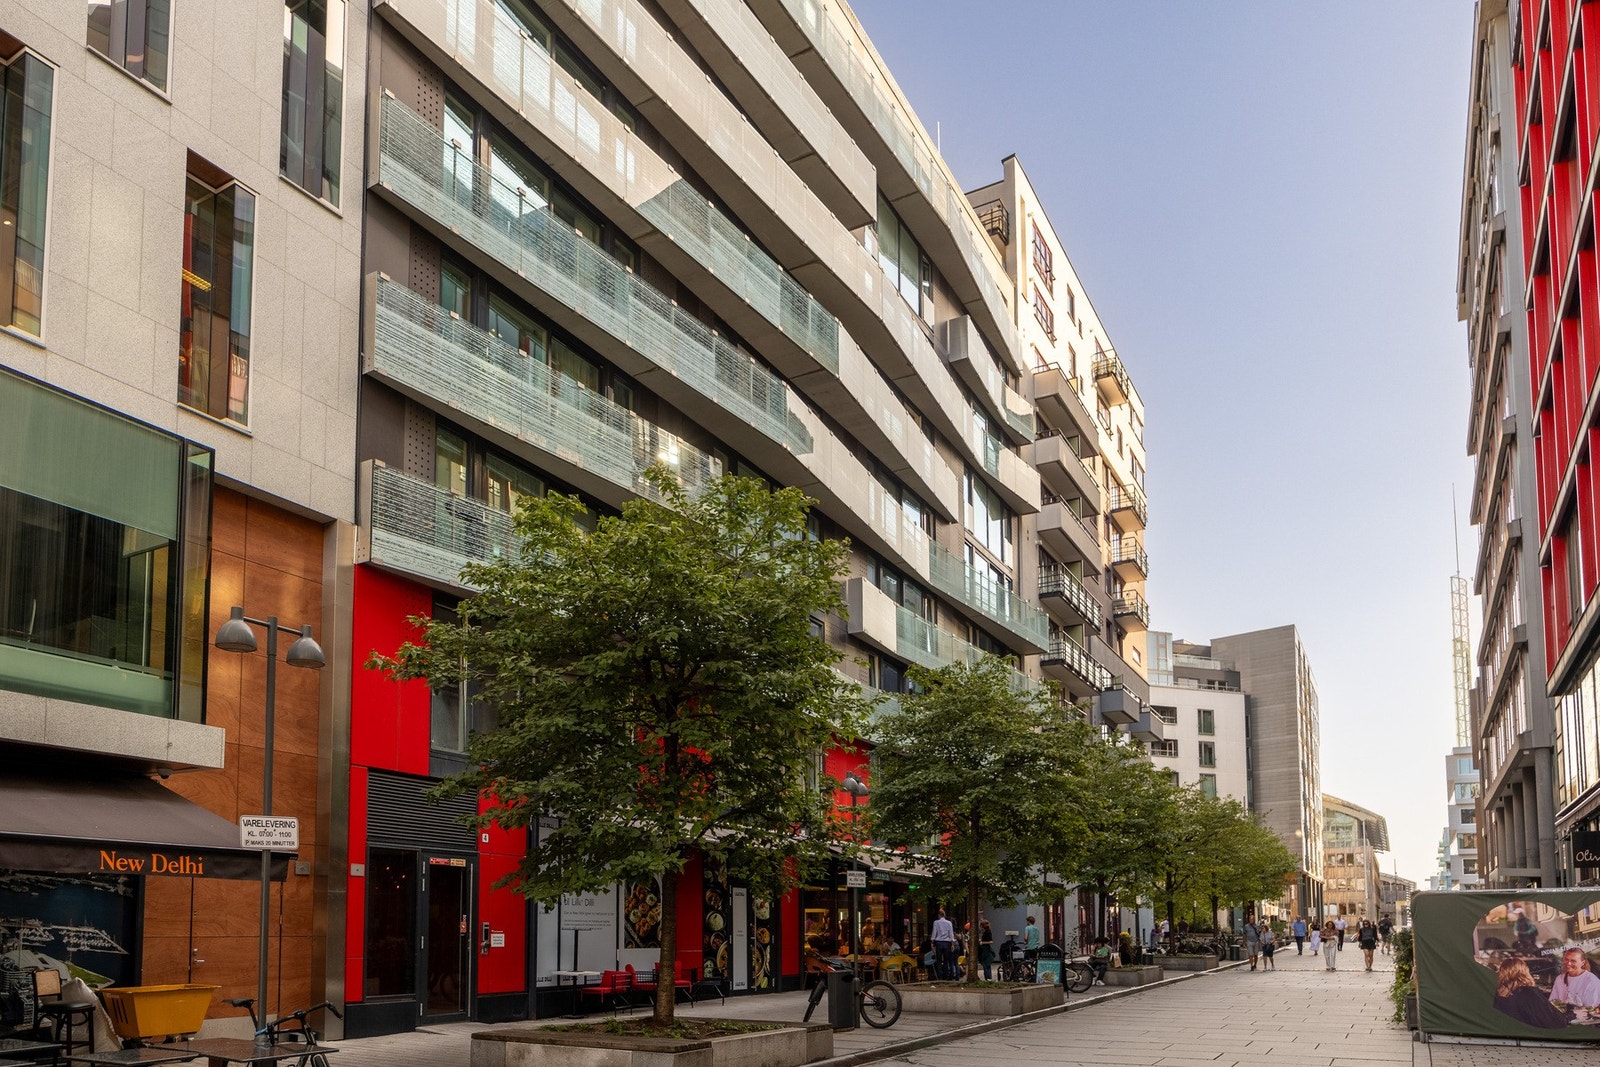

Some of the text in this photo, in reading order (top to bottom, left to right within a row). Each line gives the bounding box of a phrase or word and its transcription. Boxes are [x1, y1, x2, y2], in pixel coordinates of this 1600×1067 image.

[242, 819, 296, 829] VARELEVERING
[258, 830, 274, 838] 07:00
[100, 850, 204, 875] New Delhi
